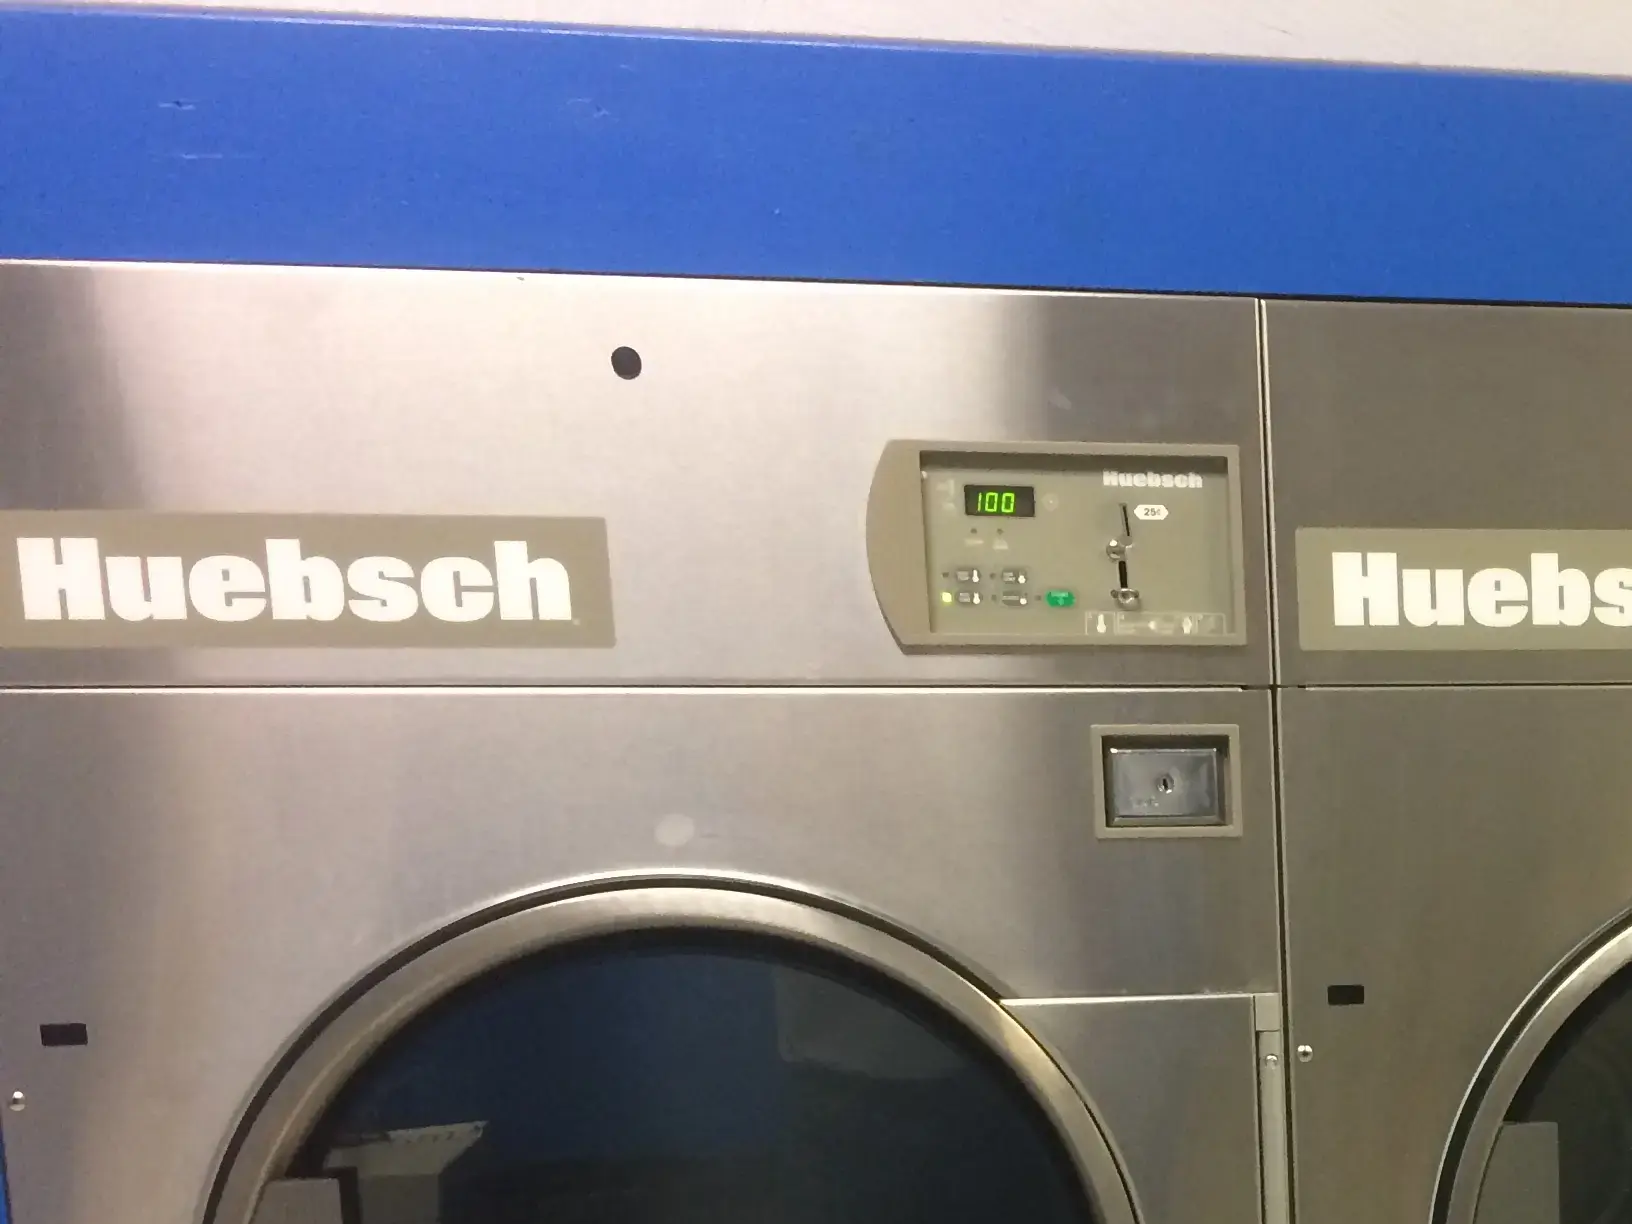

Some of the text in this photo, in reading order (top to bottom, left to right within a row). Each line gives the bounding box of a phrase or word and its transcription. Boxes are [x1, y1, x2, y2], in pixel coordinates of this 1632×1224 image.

[1103, 470, 1203, 488] Huebsch
[976, 491, 1016, 514] 100
[16, 536, 573, 622] Huebsch
